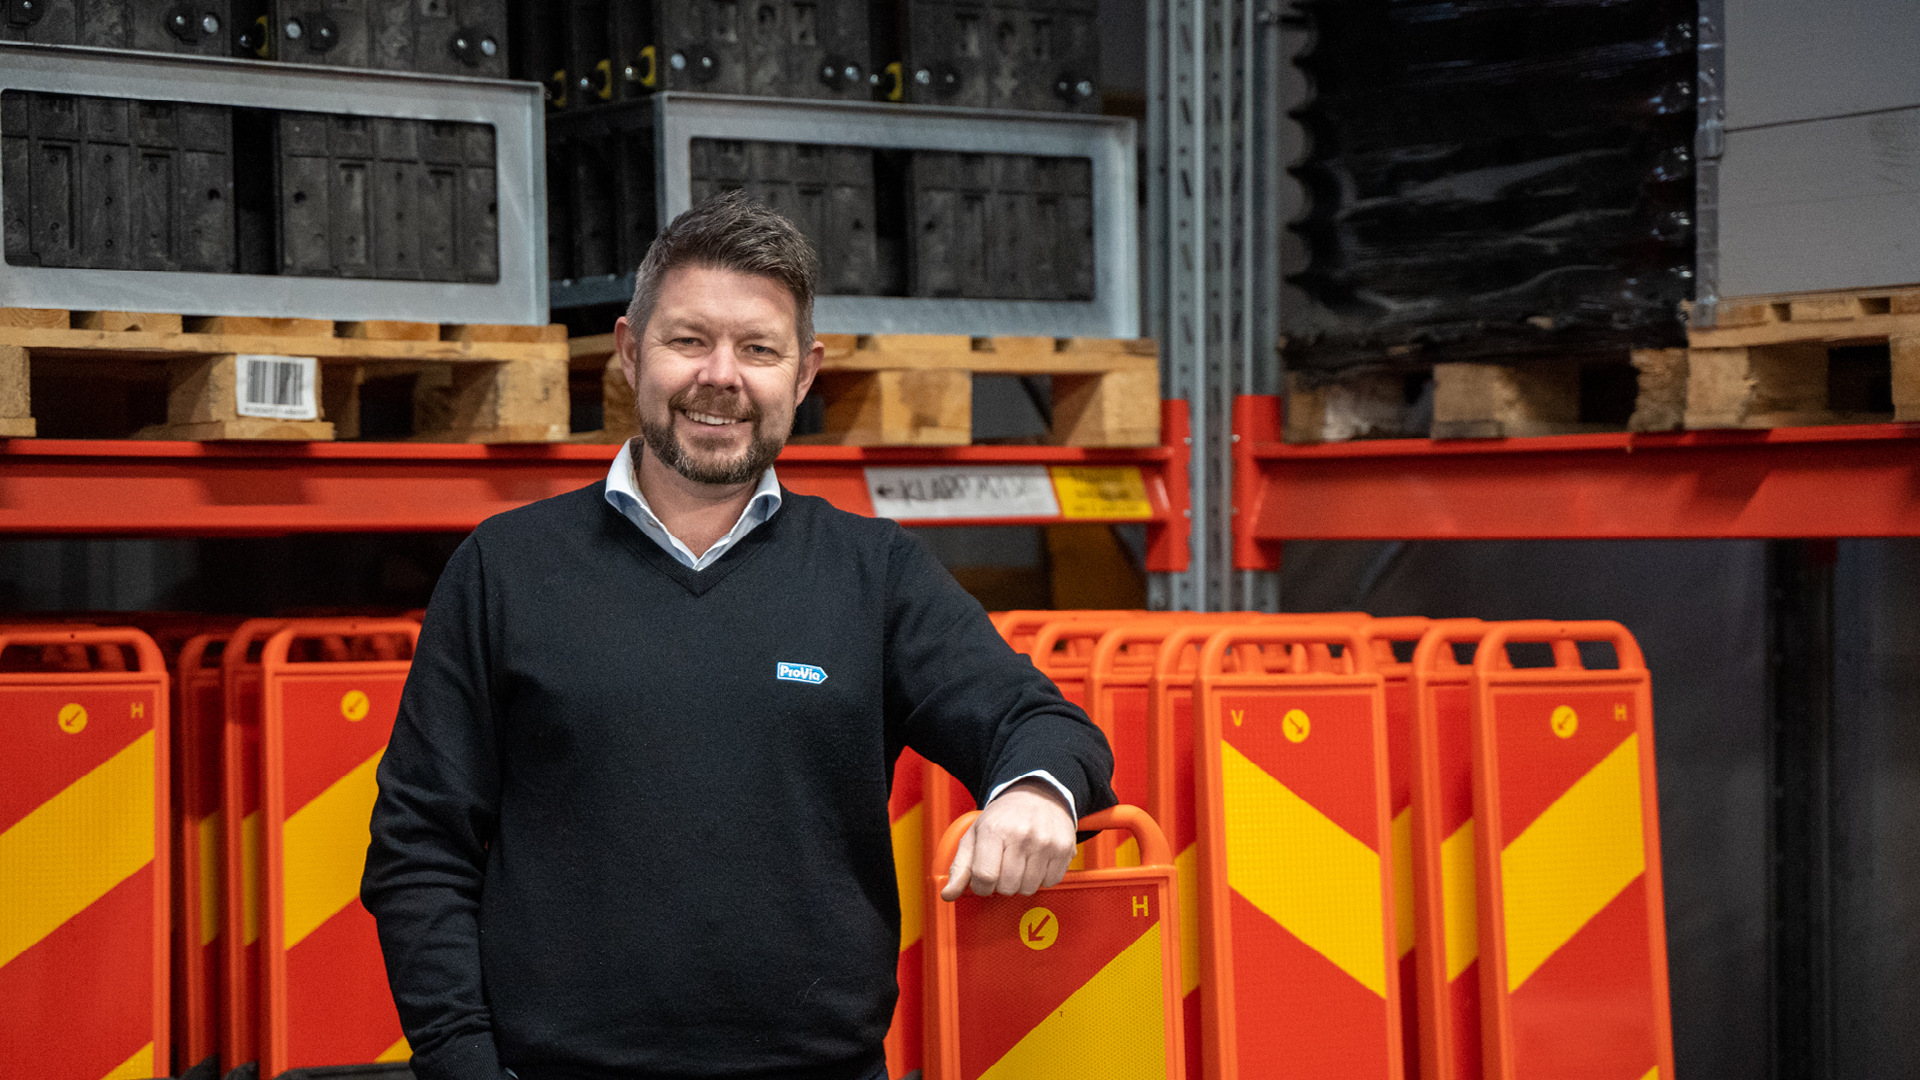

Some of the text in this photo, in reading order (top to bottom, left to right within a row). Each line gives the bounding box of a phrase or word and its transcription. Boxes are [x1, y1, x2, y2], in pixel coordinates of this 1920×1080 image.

[780, 664, 820, 681] ProVia
[131, 702, 144, 719] H
[1231, 709, 1244, 726] V
[1614, 703, 1627, 721] H
[1132, 895, 1148, 917] H
